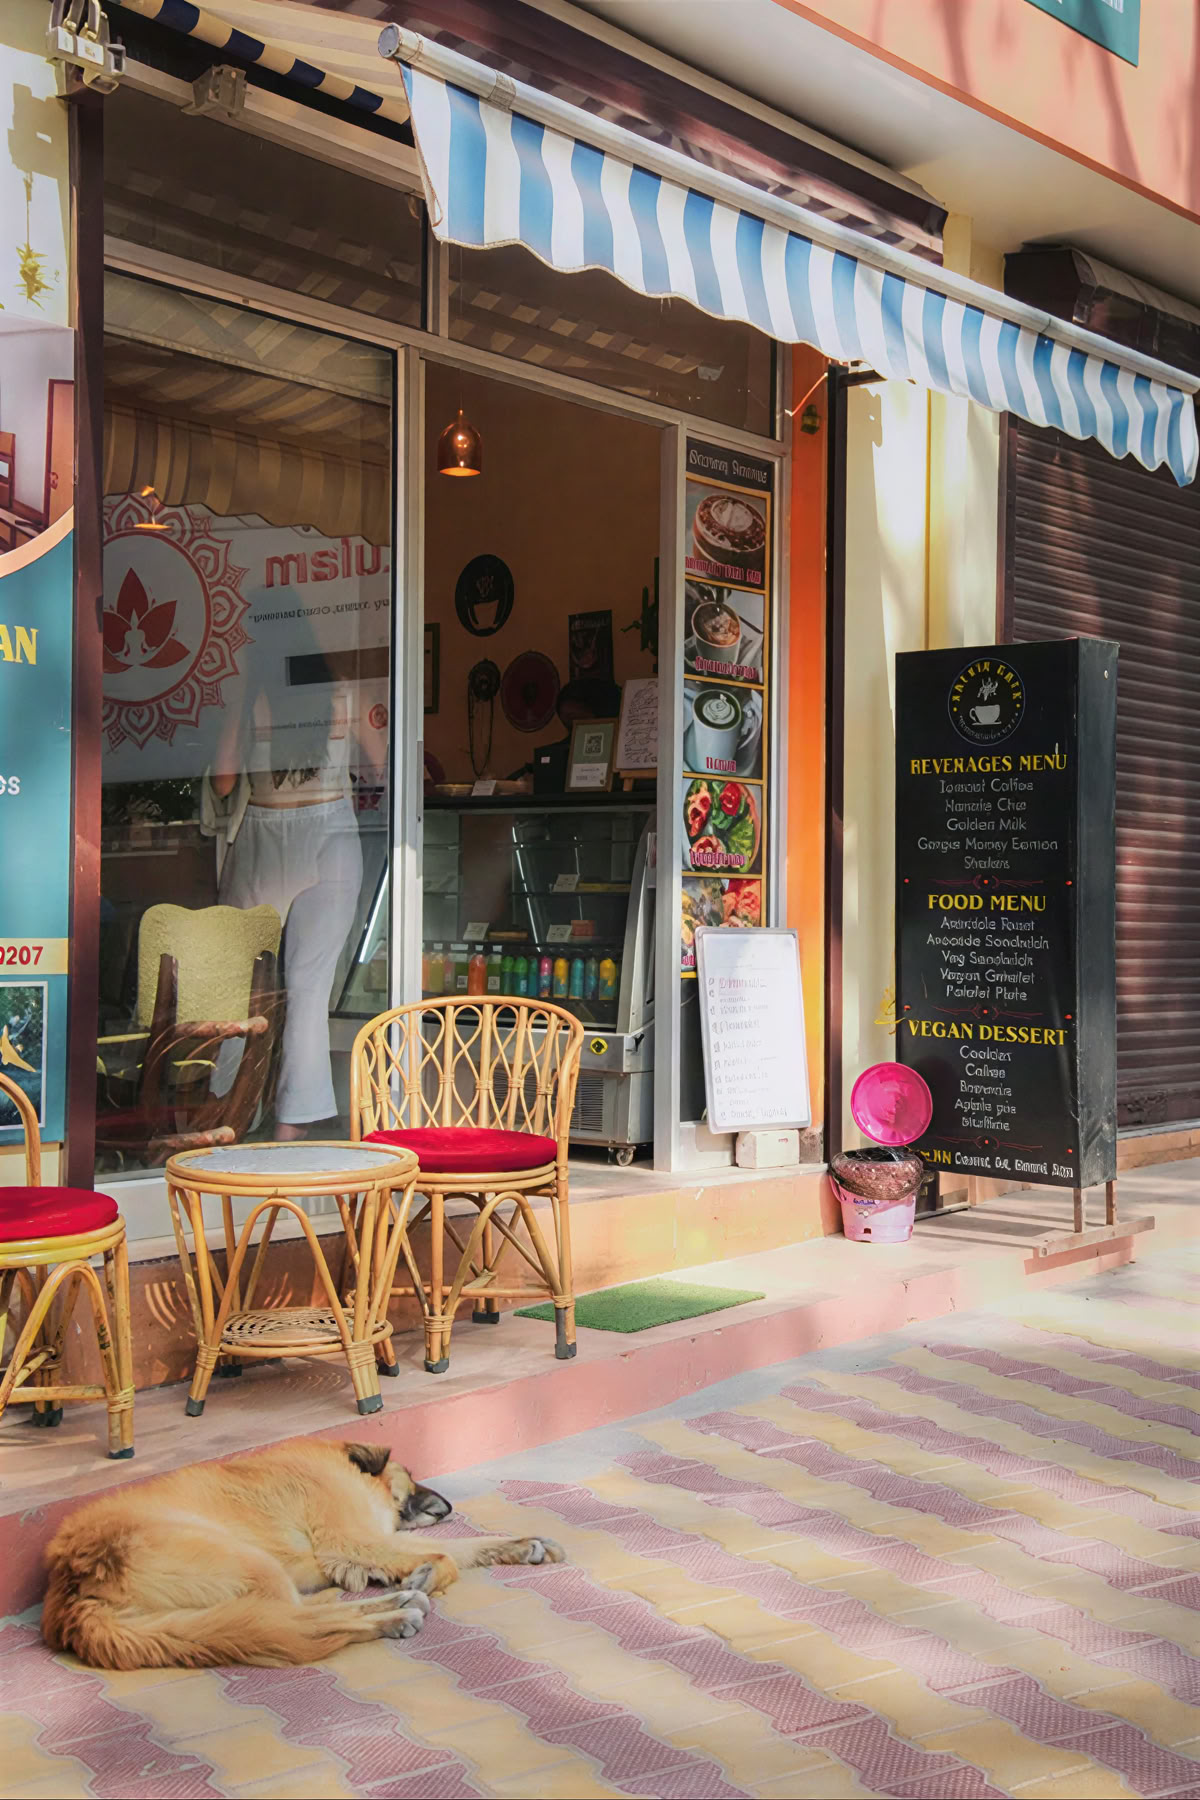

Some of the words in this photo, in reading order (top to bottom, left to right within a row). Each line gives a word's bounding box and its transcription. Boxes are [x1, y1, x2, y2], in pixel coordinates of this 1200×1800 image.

[946, 818, 995, 831] Golden
[1000, 816, 1027, 830] Milk
[928, 894, 983, 910] FOOD
[990, 895, 1046, 912] MENU
[908, 1020, 973, 1040] VEGAN
[979, 1024, 1068, 1046] DESSERT
